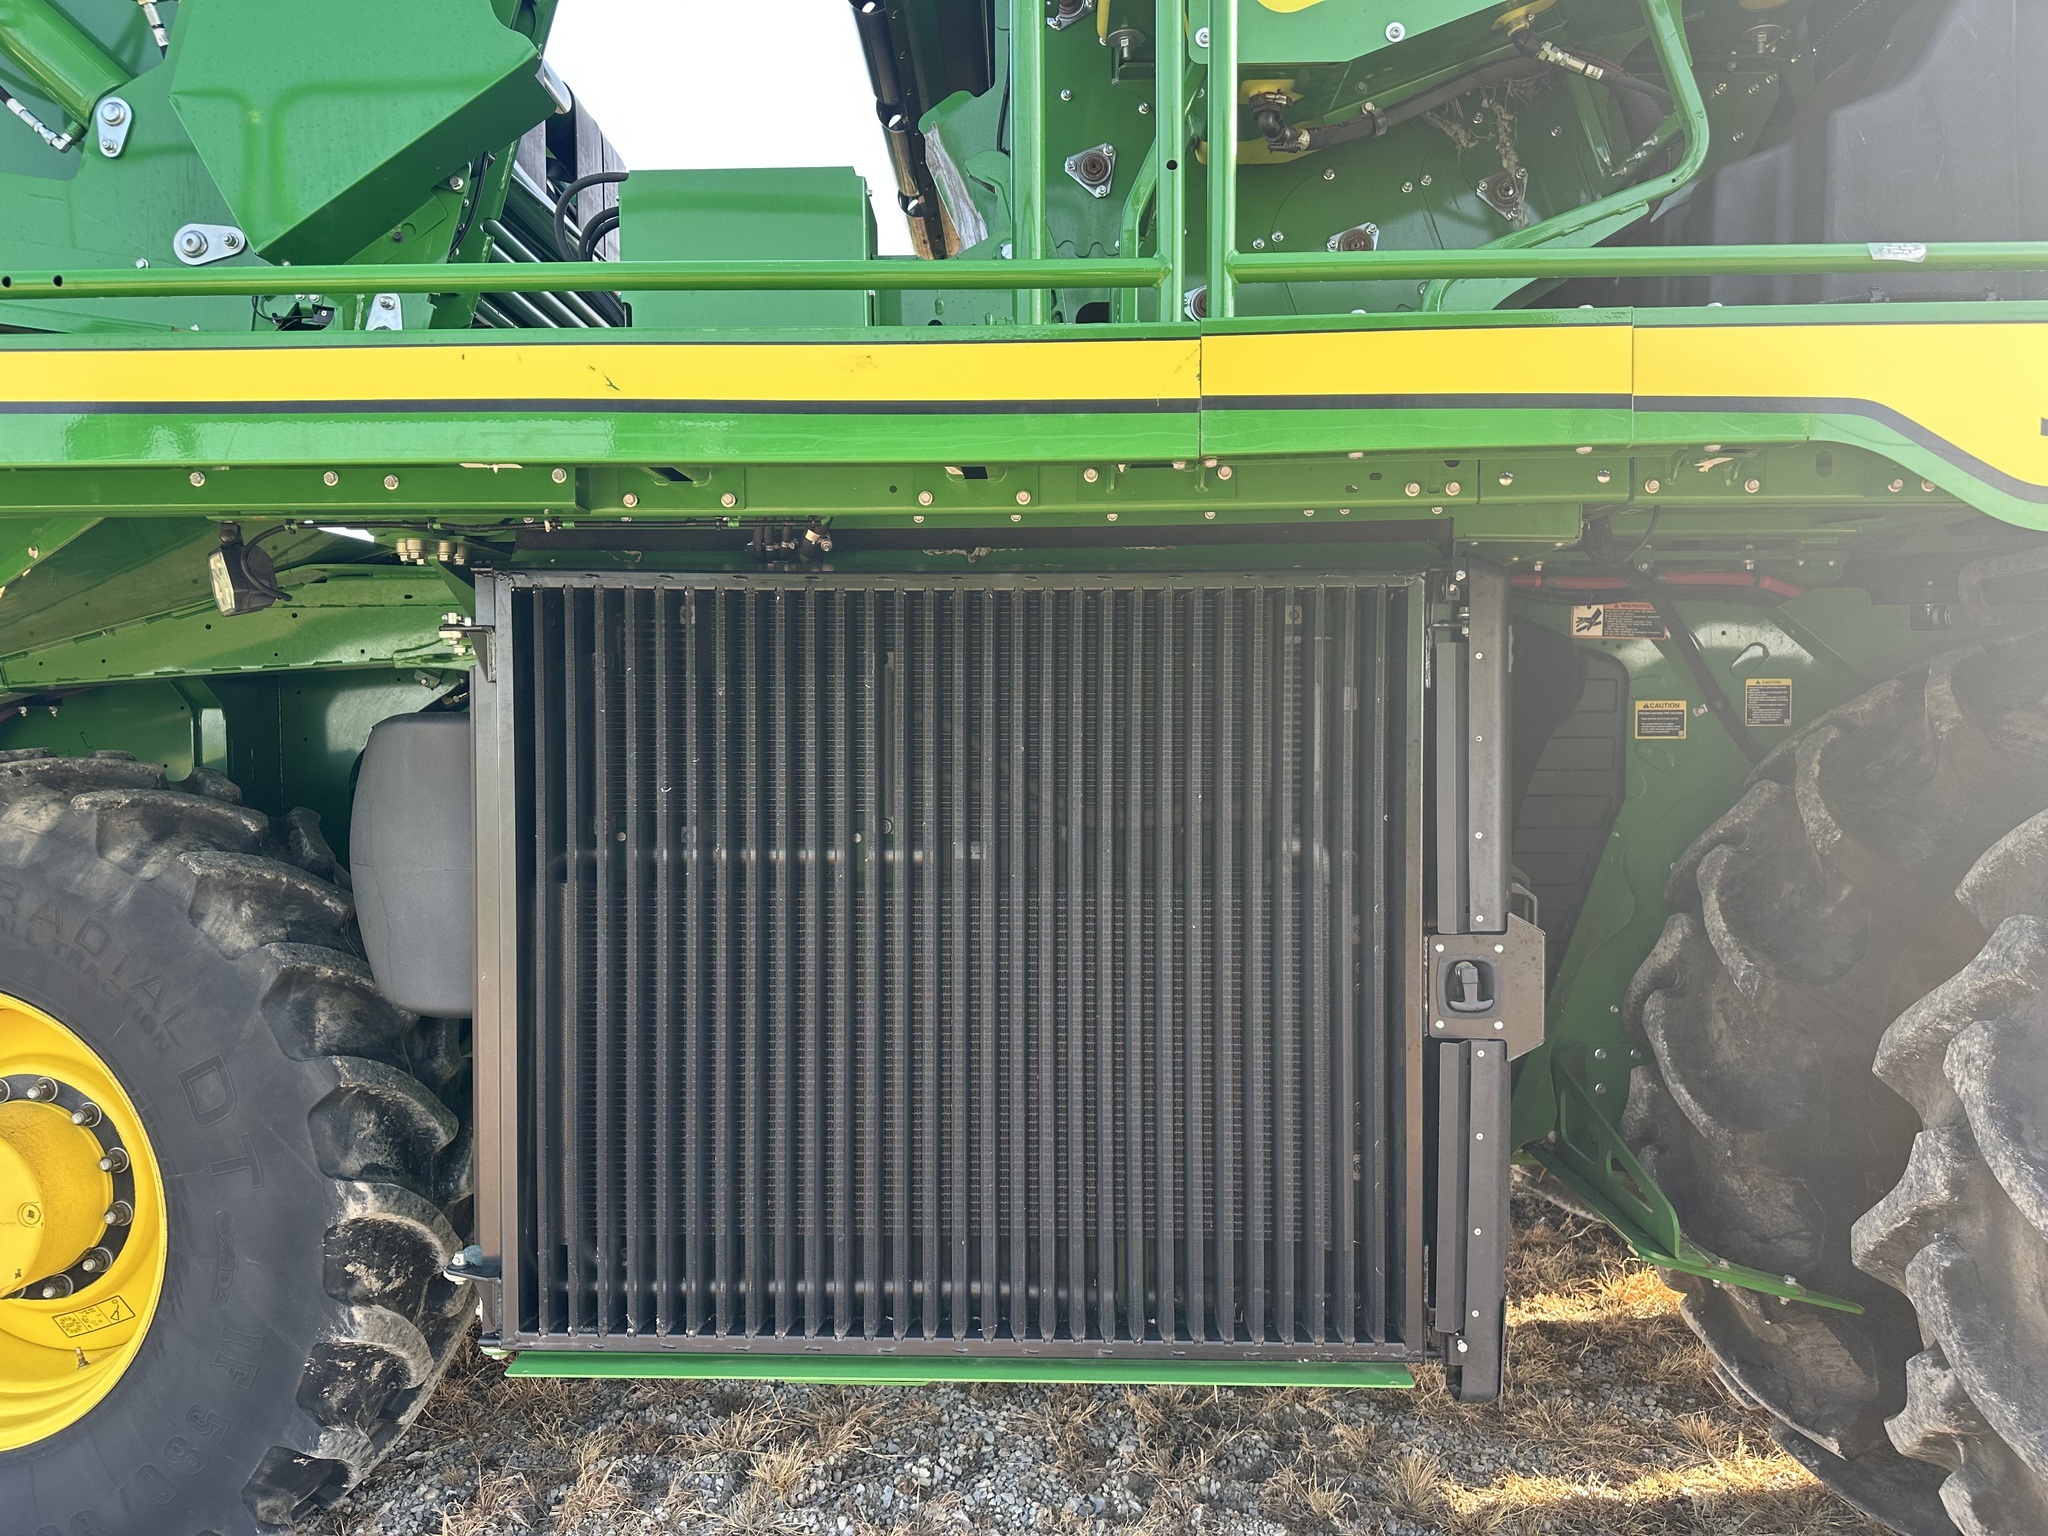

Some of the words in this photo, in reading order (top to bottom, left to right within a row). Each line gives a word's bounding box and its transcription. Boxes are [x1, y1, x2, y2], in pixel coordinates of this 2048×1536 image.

[0, 881, 190, 1048] RADIAL
[175, 1052, 263, 1189] DT
[213, 1325, 265, 1391] IF
